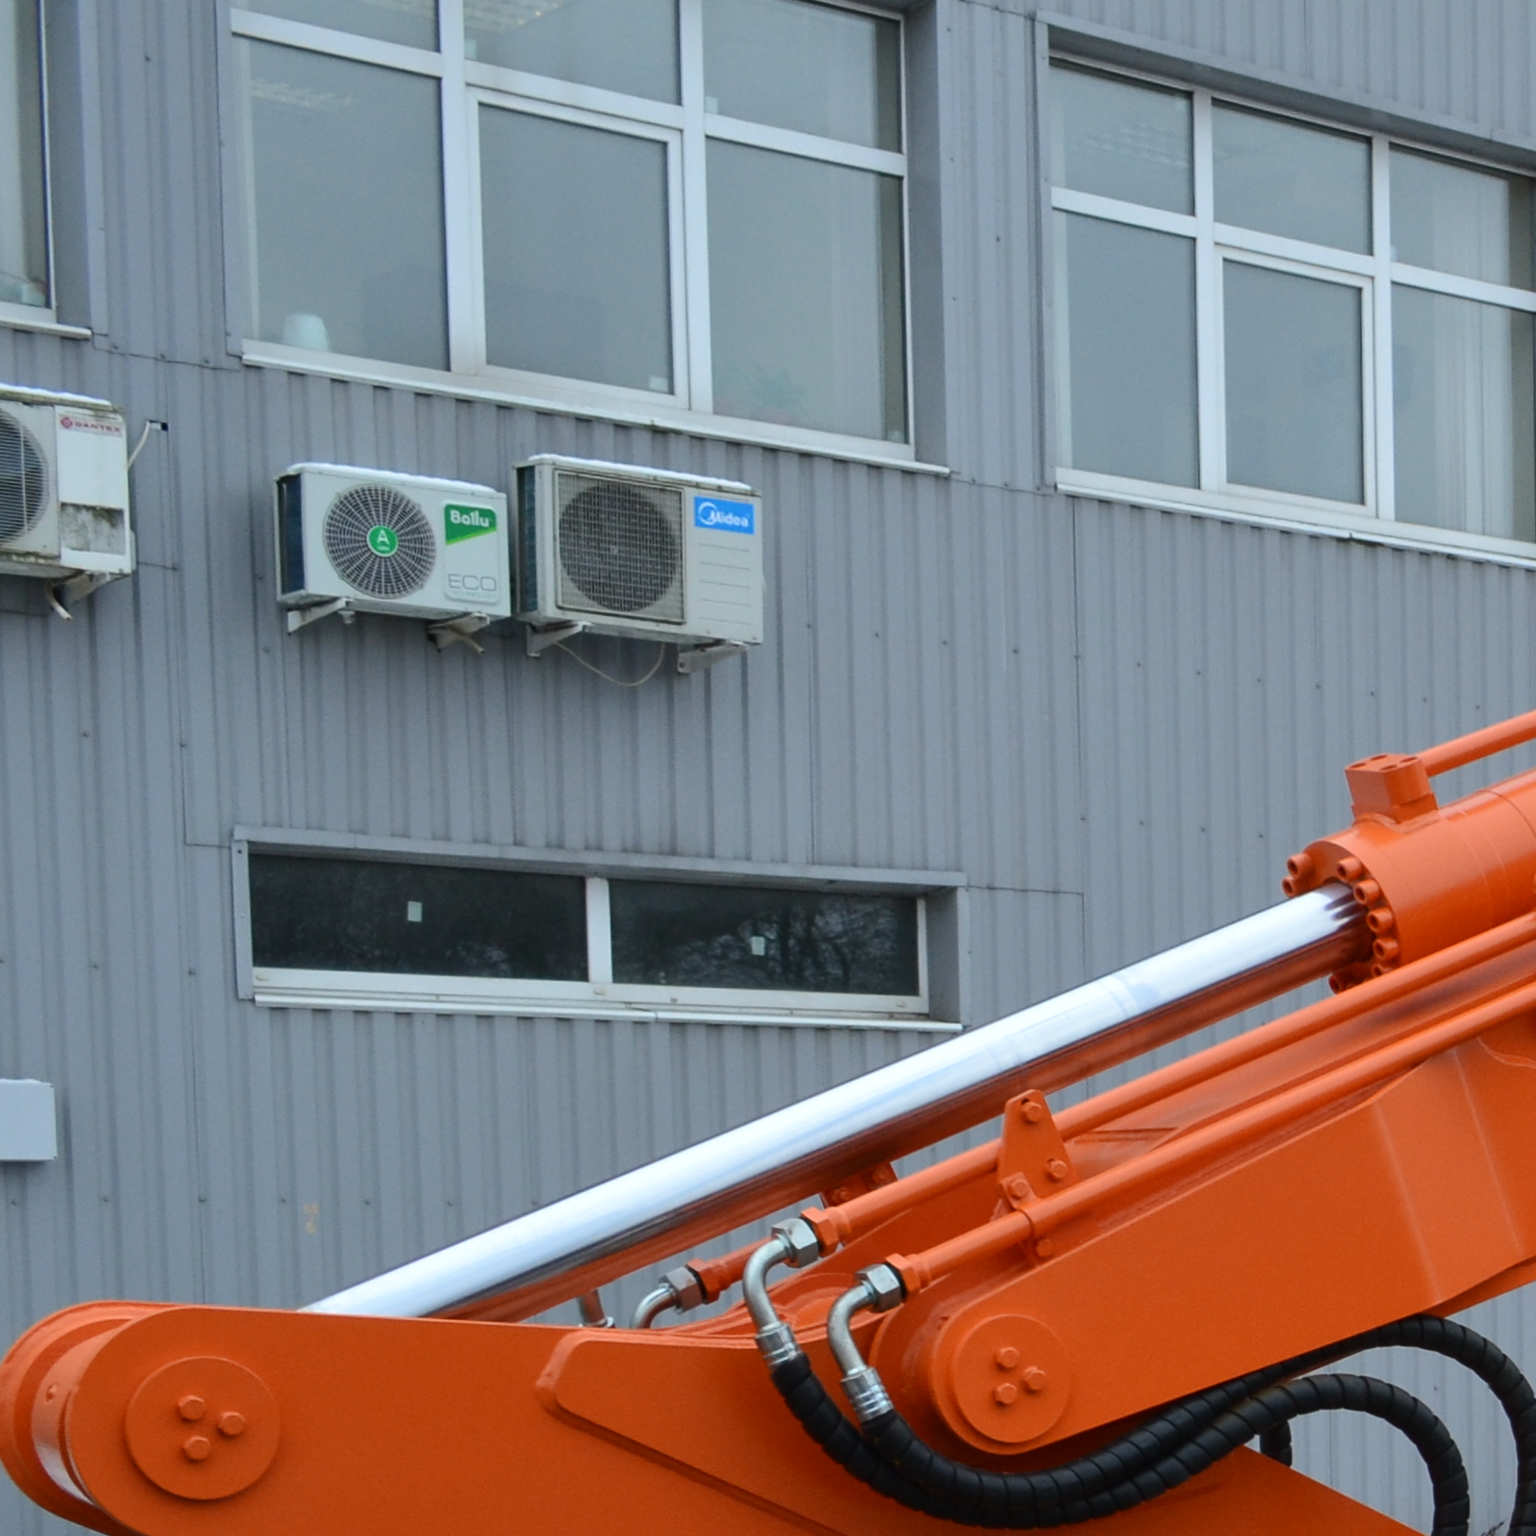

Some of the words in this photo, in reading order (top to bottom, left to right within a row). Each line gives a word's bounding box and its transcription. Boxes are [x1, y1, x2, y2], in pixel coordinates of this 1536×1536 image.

[75, 421, 120, 433] DANTEX
[449, 509, 490, 528] Ballu
[701, 504, 749, 528] Midea
[376, 529, 390, 545] A
[447, 573, 497, 592] ECO
